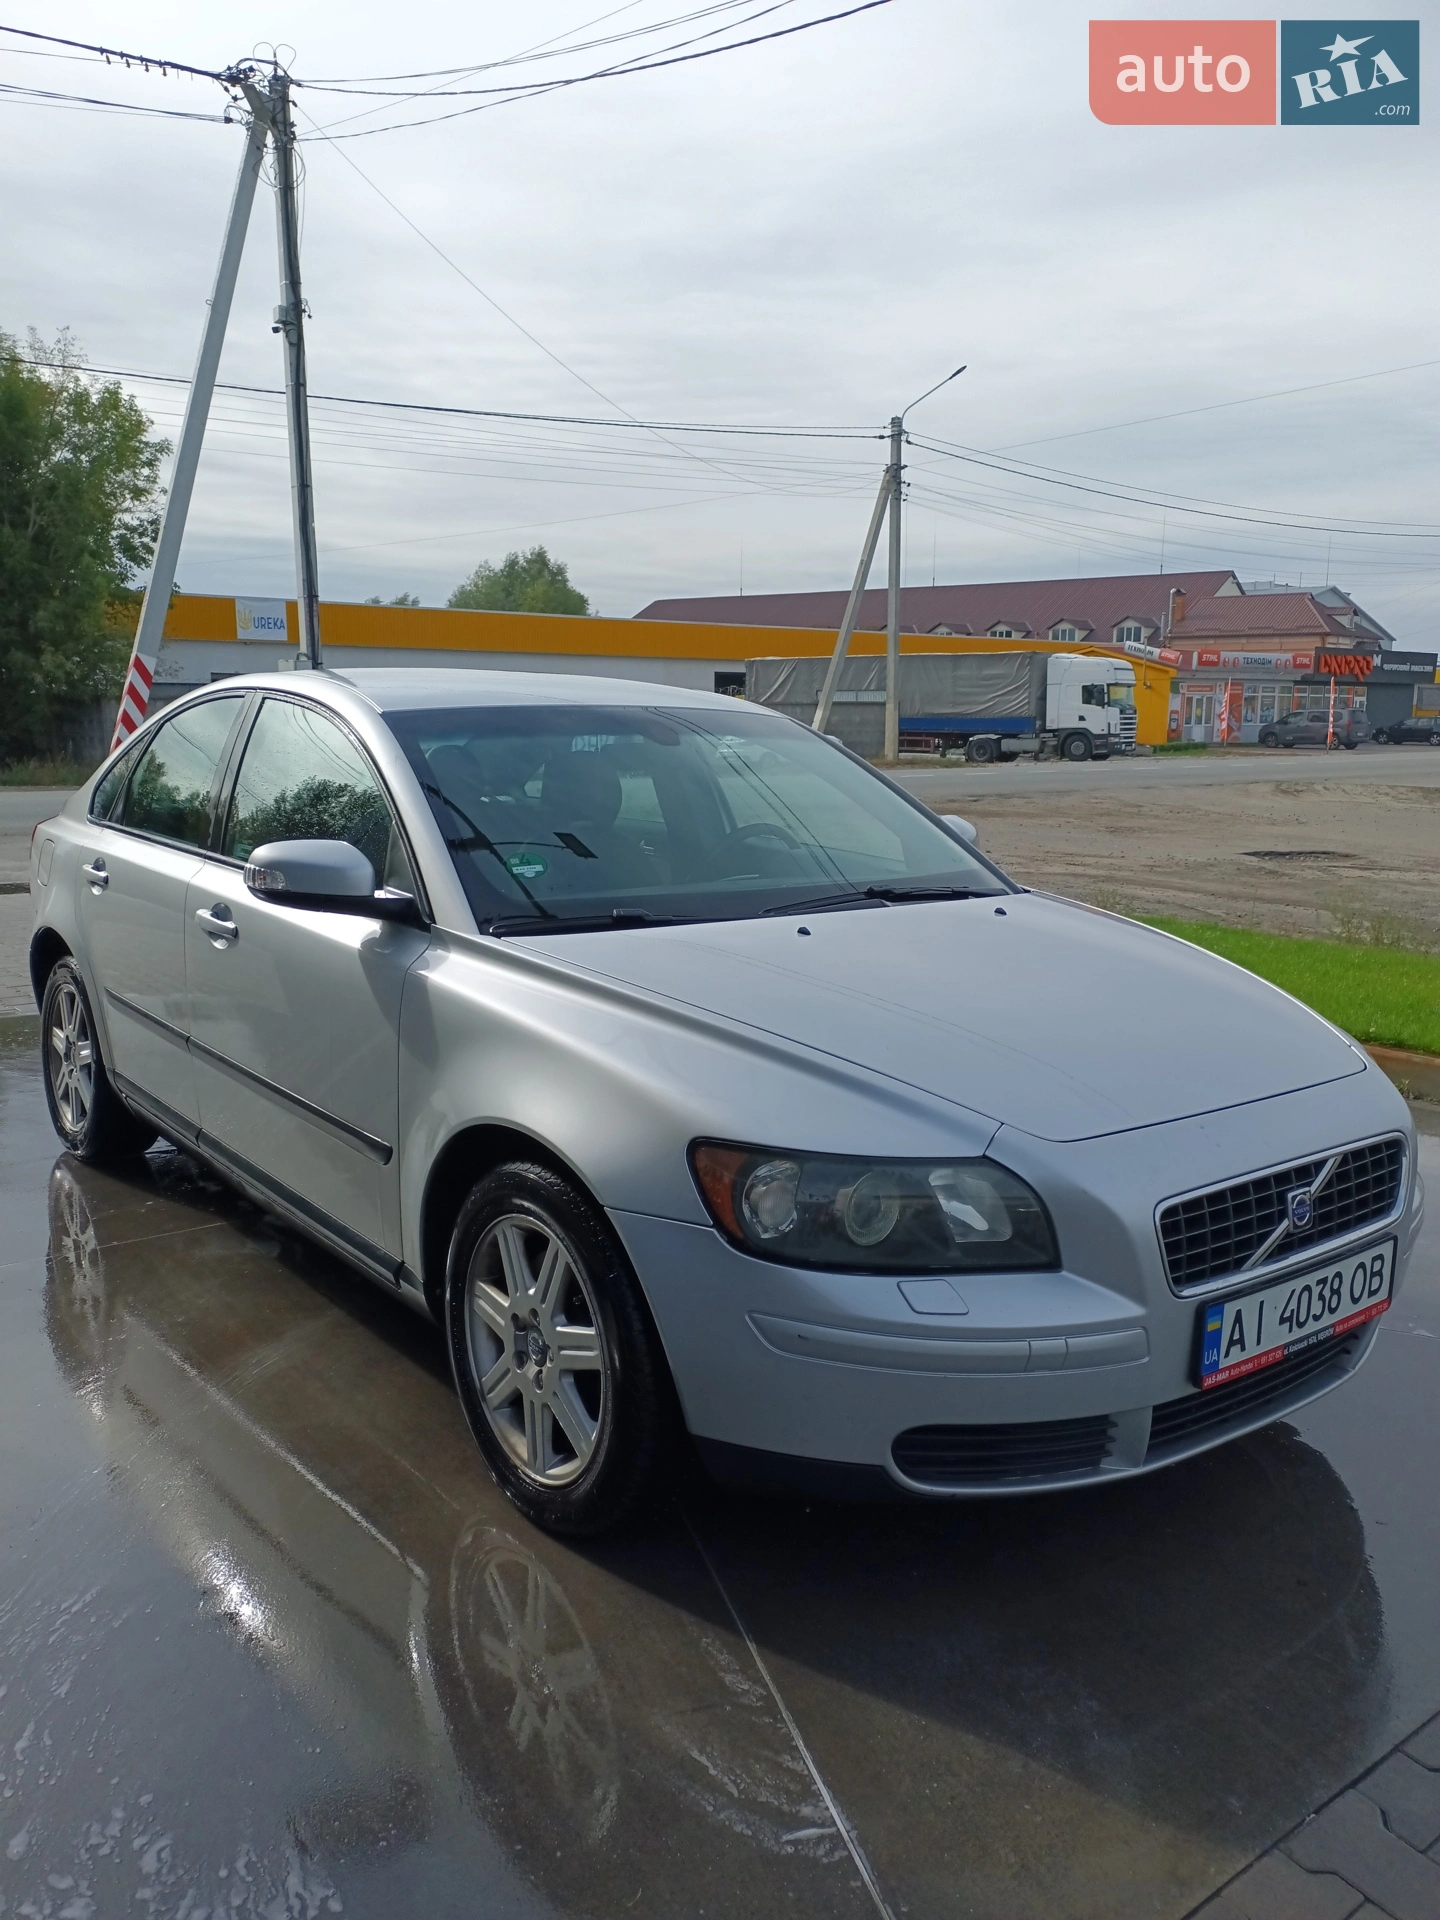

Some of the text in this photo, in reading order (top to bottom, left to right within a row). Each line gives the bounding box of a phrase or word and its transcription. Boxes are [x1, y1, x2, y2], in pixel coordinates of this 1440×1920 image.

[253, 616, 286, 630] UREKA
[1160, 651, 1176, 660] STIHL
[1201, 654, 1219, 662] STIHL
[1242, 656, 1272, 666] ТЕХНОДІМ
[1295, 657, 1311, 665] STIHL
[1223, 1253, 1385, 1359] AI 4038 OB
[1204, 1348, 1219, 1365] UA
